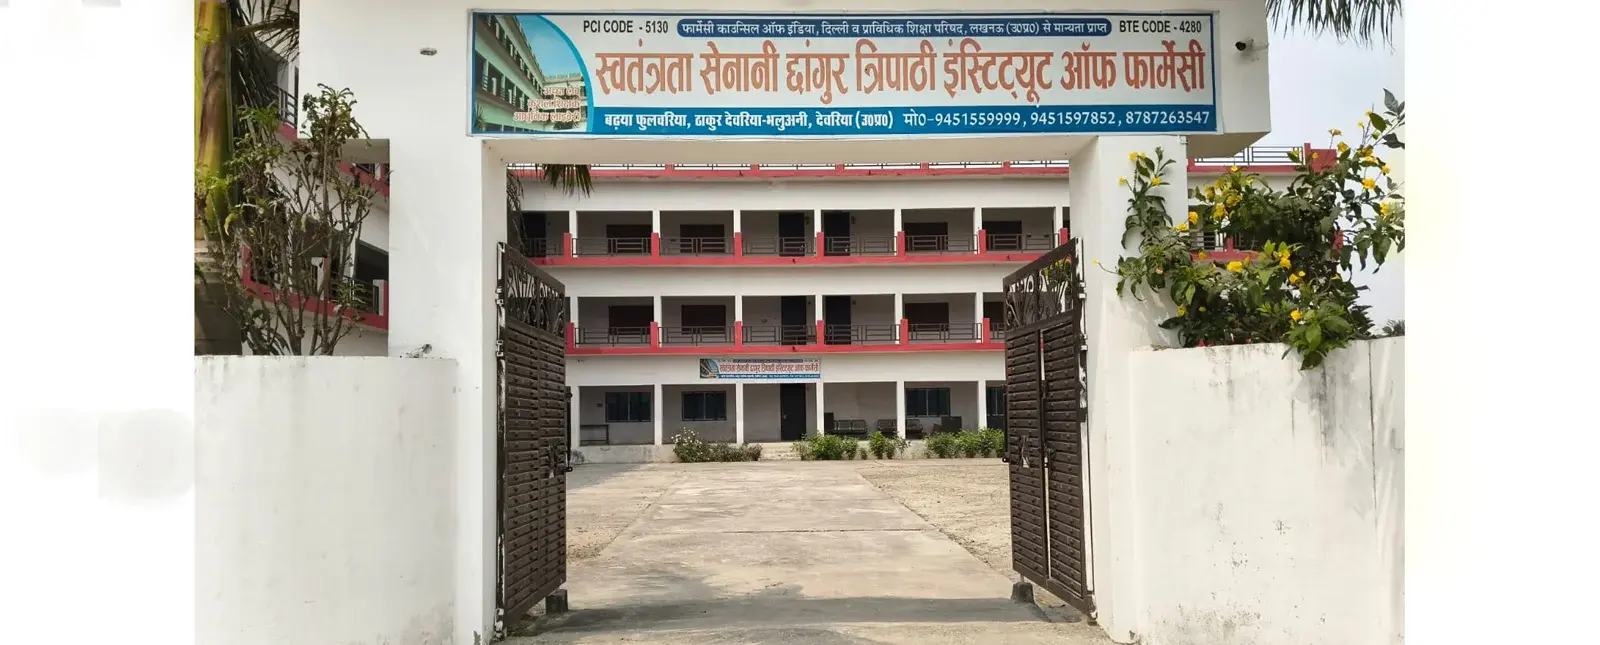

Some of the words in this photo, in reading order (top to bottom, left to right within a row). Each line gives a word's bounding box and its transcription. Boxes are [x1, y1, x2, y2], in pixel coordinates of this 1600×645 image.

[583, 19, 601, 33] PCI
[603, 19, 633, 33] CODE
[645, 20, 669, 34] 5130
[681, 20, 715, 34] फार्मेसी
[762, 20, 786, 34] ऑफ
[821, 20, 850, 35] दिल्ली
[852, 23, 860, 34] व
[906, 20, 932, 34] शिक्षा
[970, 22, 1004, 34] लखनऊ
[1042, 19, 1052, 33] से
[1053, 22, 1085, 33] मान्यता
[1087, 22, 1108, 34] प्राप्त
[1119, 19, 1140, 33] BTE
[1142, 19, 1172, 33] CODE
[1179, 20, 1203, 34] 4280
[595, 39, 694, 96] स्वतंत्रता
[700, 40, 779, 96] सेनानी
[855, 39, 937, 95] त्रिपाठी
[1060, 43, 1117, 91] ऑफ
[1123, 39, 1206, 92] फार्मेसी
[694, 112, 723, 130] ठाकुर
[815, 111, 854, 127] देवरिया
[1126, 111, 1209, 124] 8787263547
